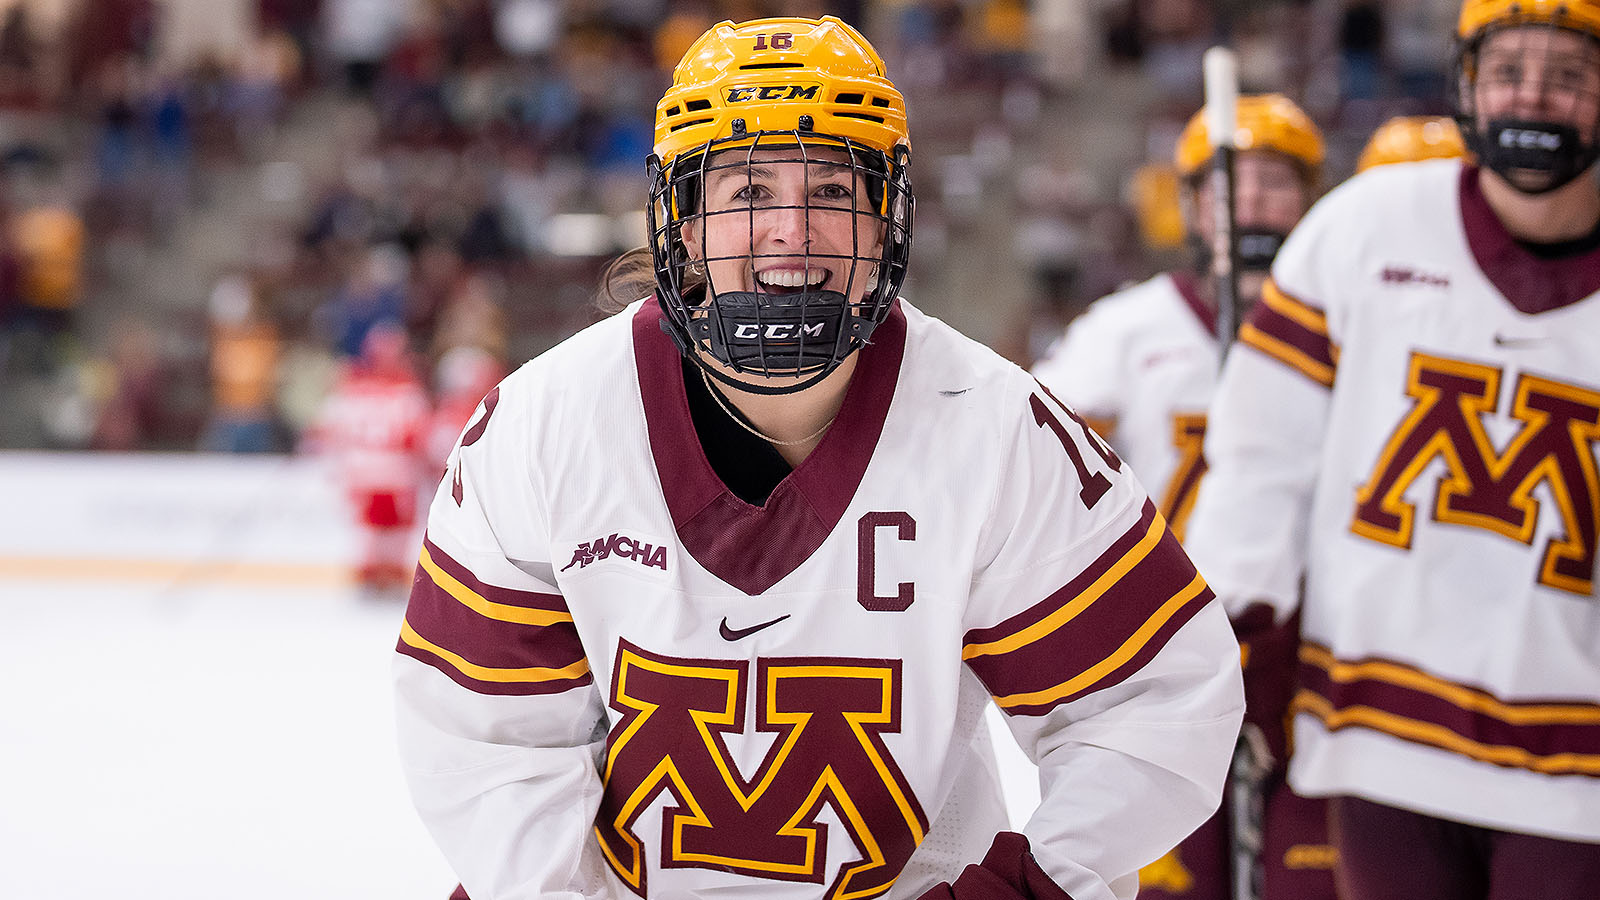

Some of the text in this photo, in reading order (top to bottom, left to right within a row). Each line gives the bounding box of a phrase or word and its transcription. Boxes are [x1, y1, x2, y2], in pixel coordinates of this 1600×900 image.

[753, 32, 793, 51] 16
[726, 84, 821, 103] CCM
[1499, 127, 1561, 151] CCM
[733, 322, 826, 340] CCM
[577, 532, 667, 571] WCHA
[857, 511, 916, 612] C
[594, 636, 930, 900] M
